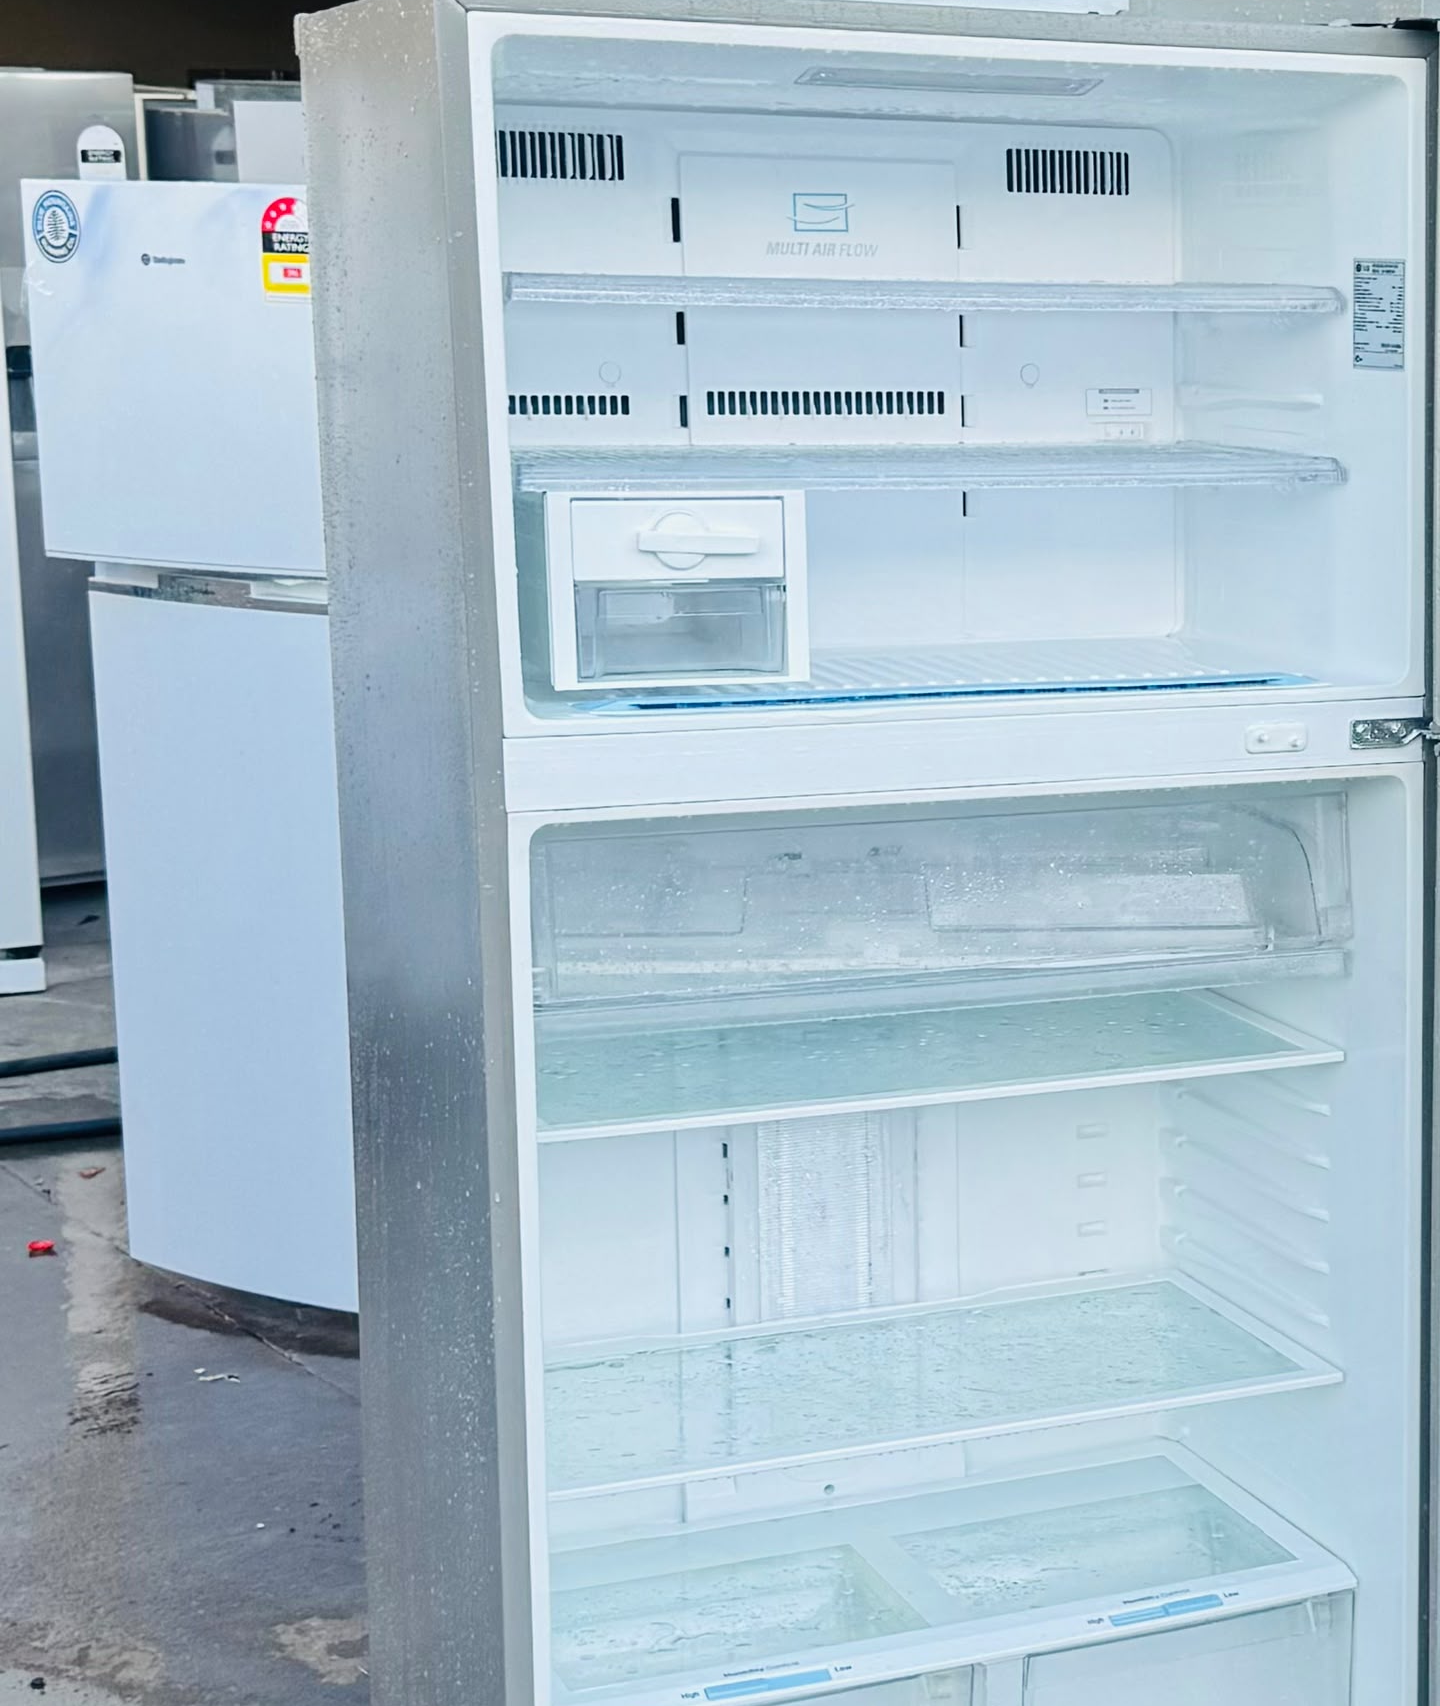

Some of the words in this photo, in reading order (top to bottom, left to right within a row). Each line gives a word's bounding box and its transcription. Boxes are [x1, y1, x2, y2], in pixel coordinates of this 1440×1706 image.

[766, 241, 809, 256] MULTI
[812, 242, 836, 257] AIR
[839, 243, 879, 258] FLOW
